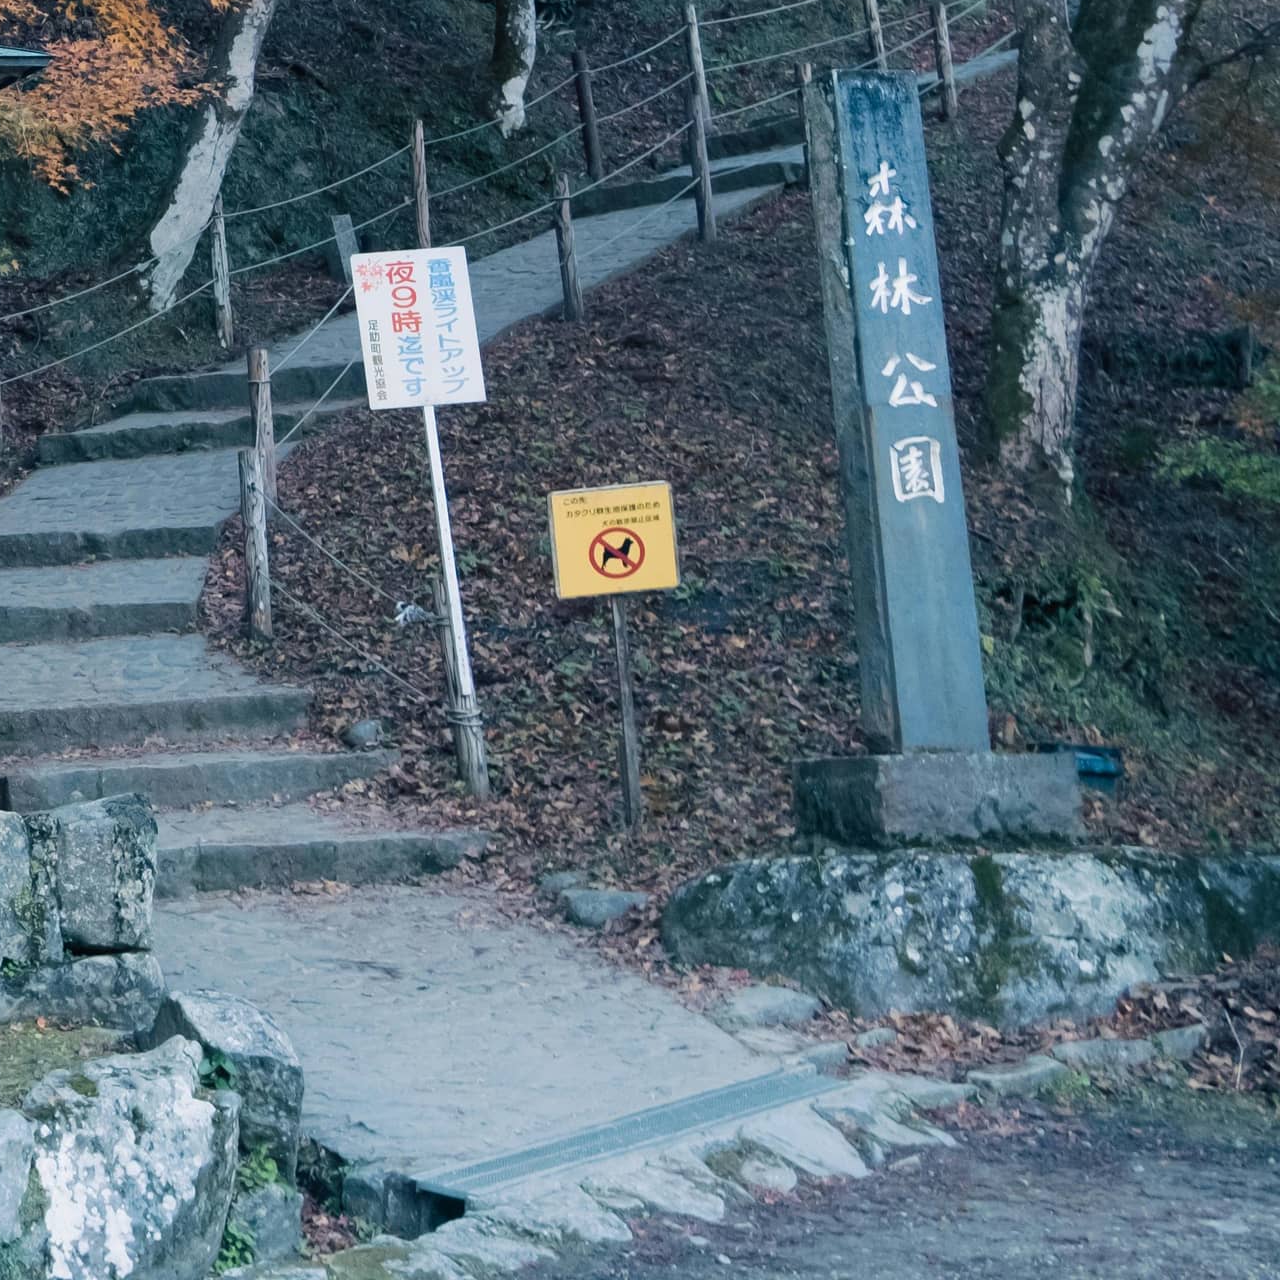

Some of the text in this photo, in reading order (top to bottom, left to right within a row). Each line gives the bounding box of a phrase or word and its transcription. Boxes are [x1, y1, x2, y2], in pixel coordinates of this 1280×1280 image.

[368, 319, 387, 401] 足助町観光協会
[385, 260, 427, 397] 夜9時迄です
[425, 258, 470, 395] 香嵐渓ライトアップ
[864, 161, 945, 504] 森林公園
